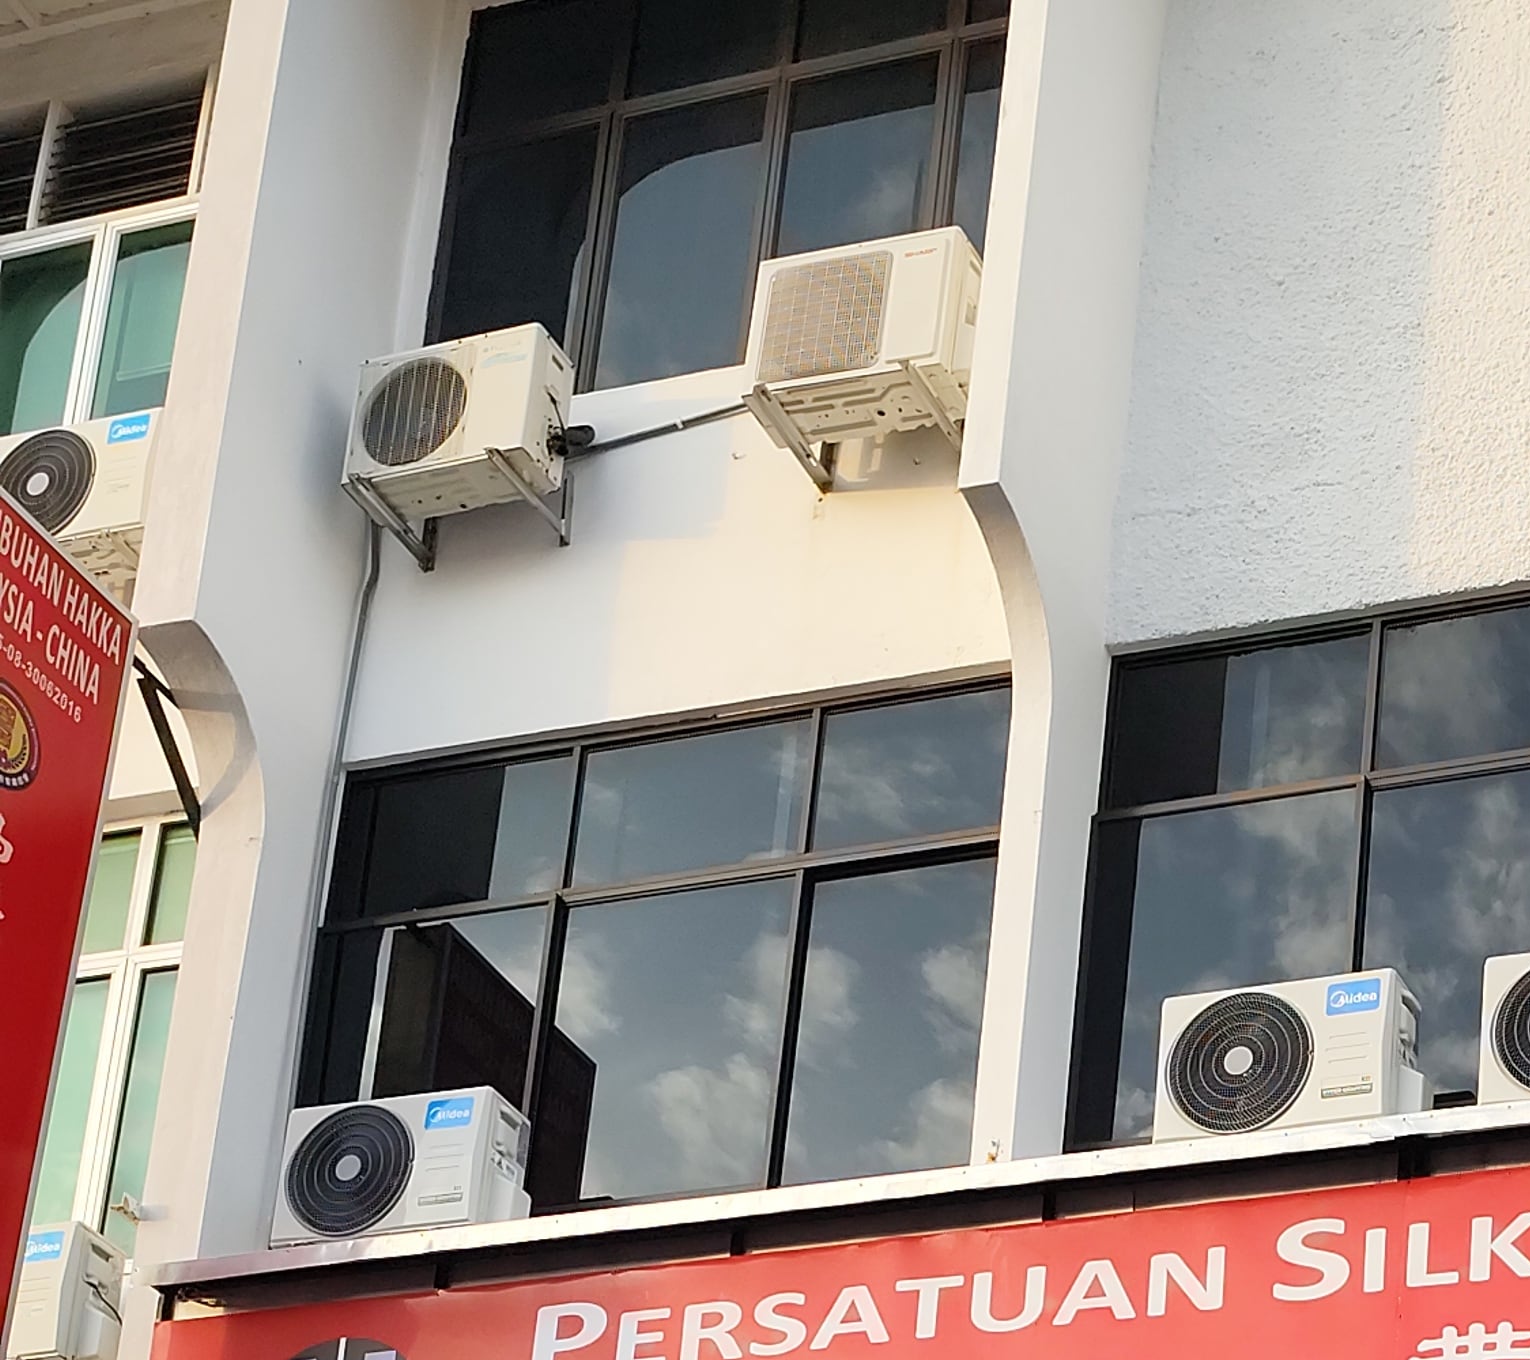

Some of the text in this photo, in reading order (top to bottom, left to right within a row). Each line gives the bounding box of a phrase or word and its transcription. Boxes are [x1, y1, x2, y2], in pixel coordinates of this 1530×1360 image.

[0, 510, 122, 665] BUHAN HAKKA
[45, 624, 100, 704] CHINA
[1330, 990, 1377, 1008] Midea
[429, 1107, 470, 1123] Midea
